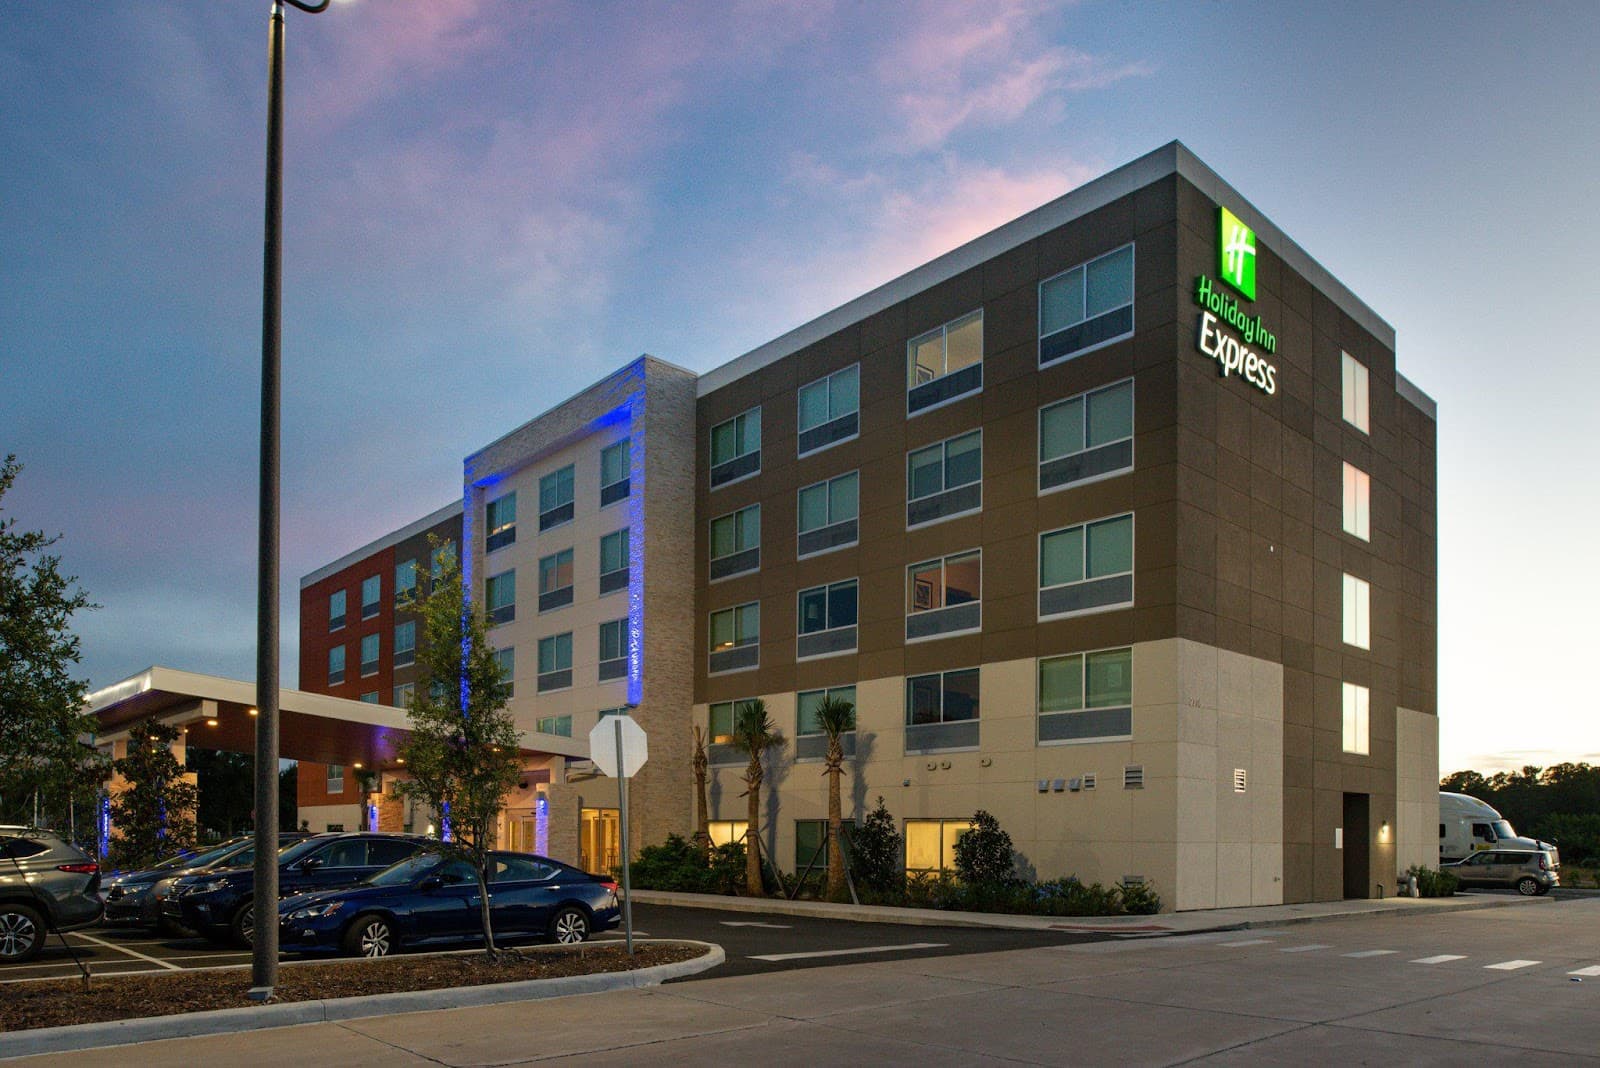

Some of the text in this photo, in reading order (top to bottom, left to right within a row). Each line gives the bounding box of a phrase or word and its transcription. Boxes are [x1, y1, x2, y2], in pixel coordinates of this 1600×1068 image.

[1199, 274, 1276, 353] Holiday Inn
[1200, 311, 1276, 395] Express
